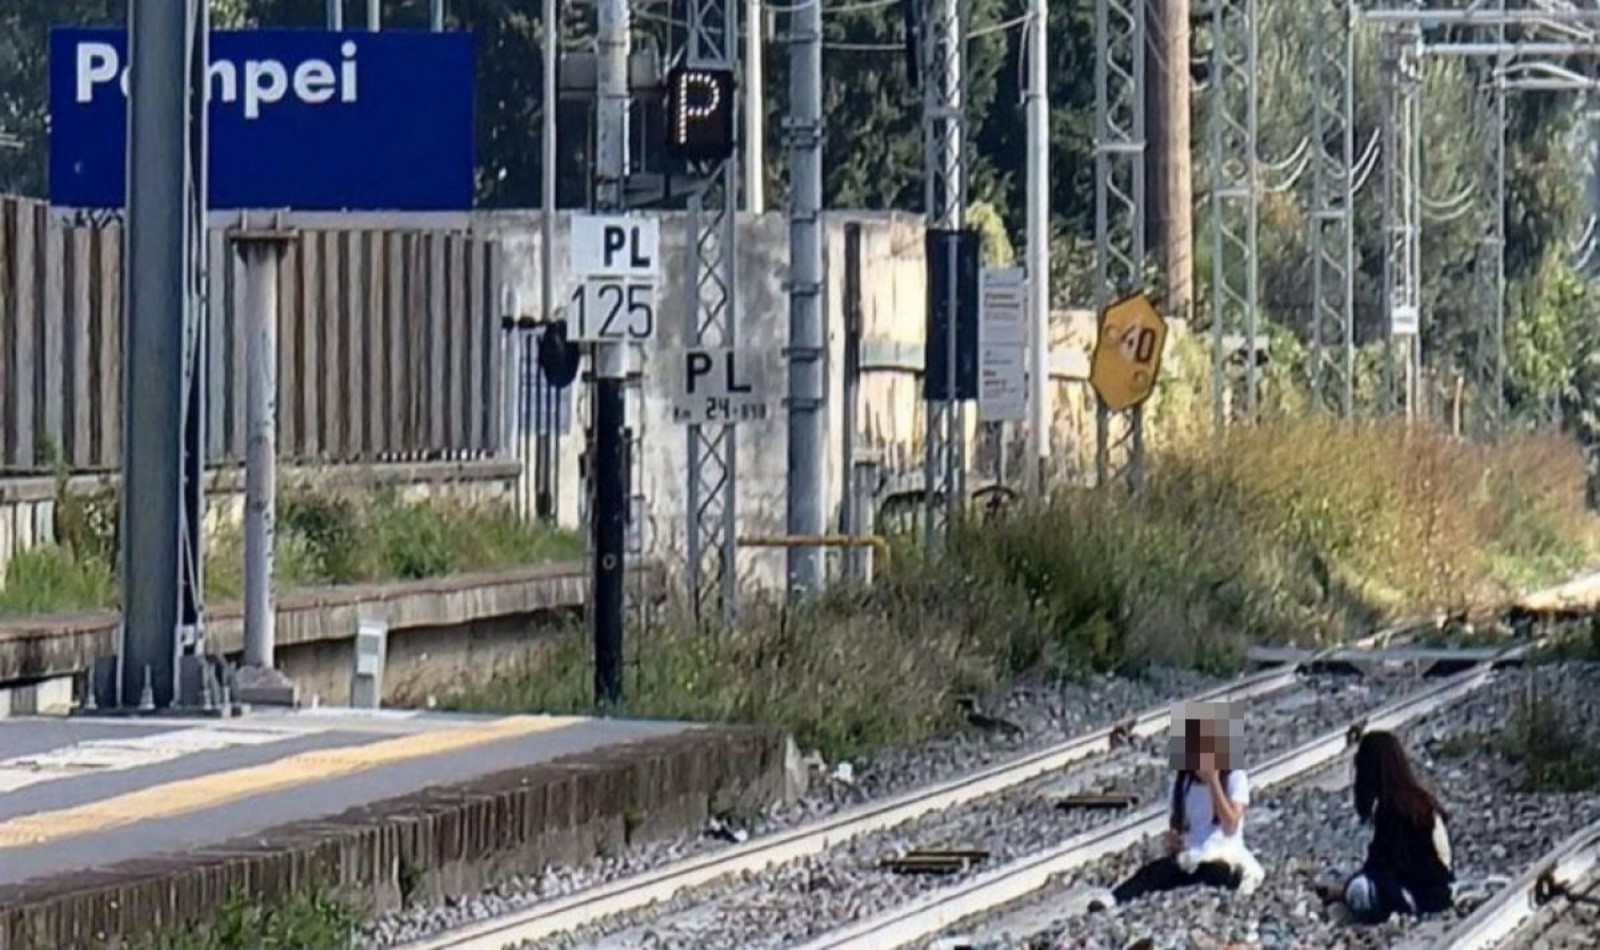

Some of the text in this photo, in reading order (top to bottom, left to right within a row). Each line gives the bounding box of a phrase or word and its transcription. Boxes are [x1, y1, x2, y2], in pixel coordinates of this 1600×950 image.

[679, 73, 719, 144] P
[604, 226, 651, 267] PL
[571, 284, 652, 338] 125
